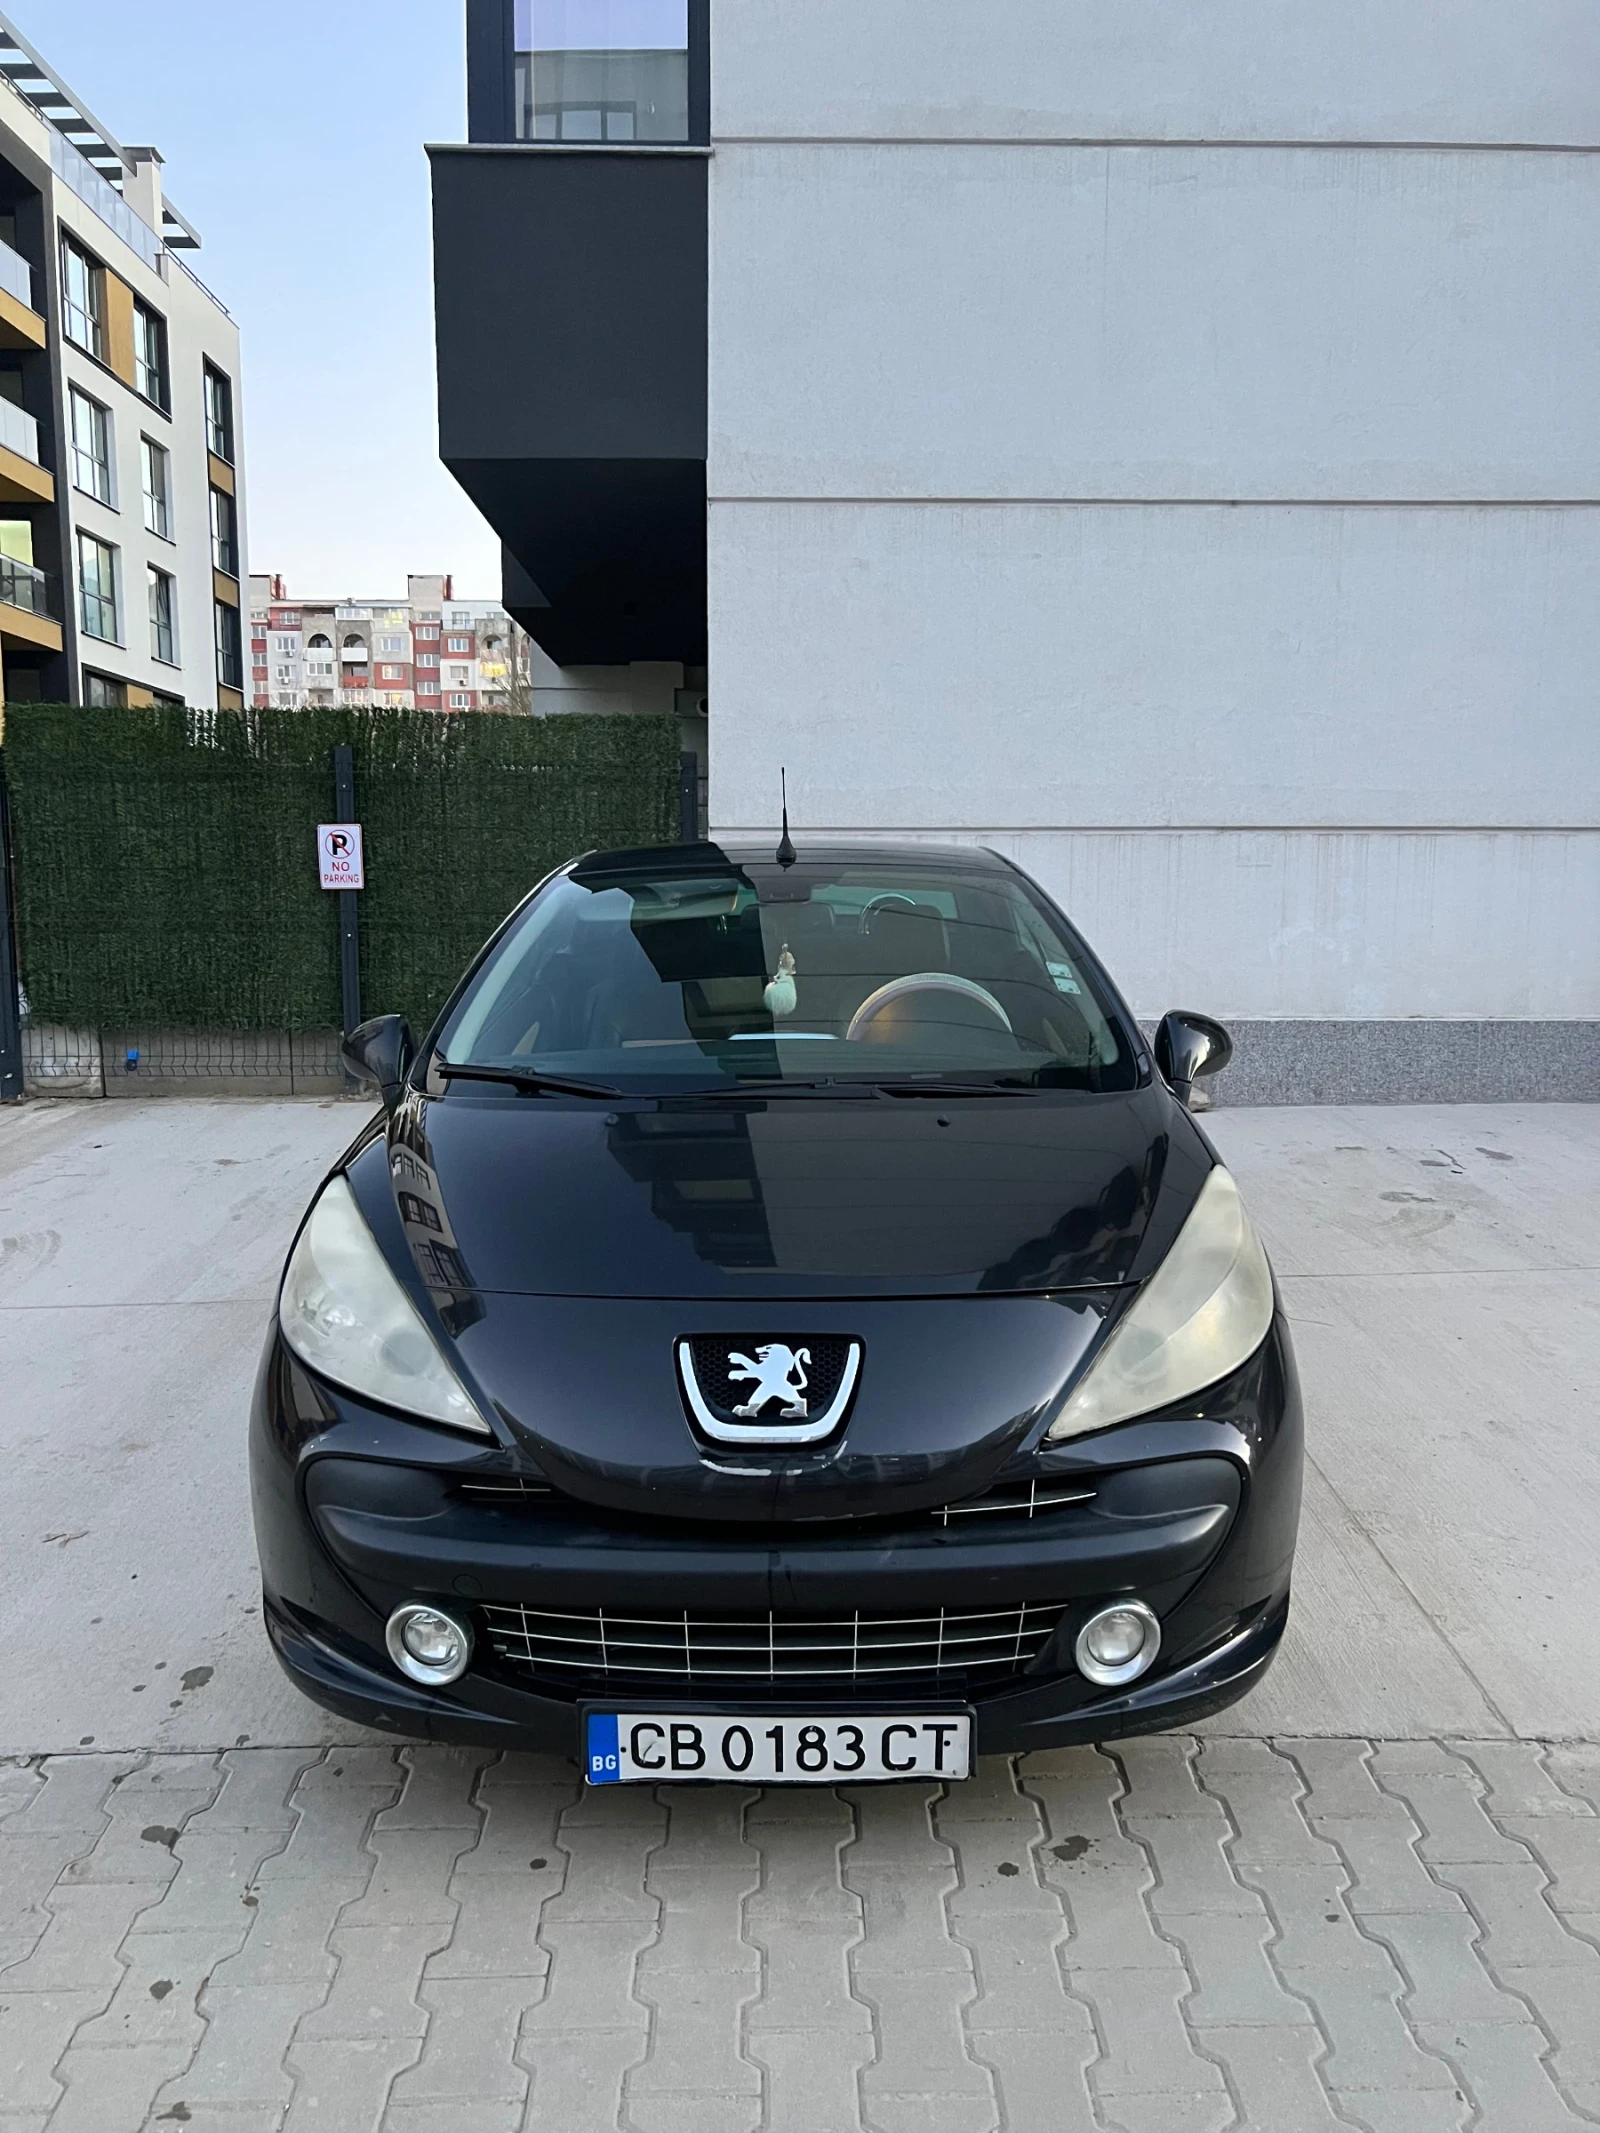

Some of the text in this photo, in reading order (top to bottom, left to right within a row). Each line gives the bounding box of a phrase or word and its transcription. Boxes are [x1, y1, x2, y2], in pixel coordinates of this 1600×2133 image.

[332, 834, 347, 855] P
[332, 862, 350, 871] NO
[324, 874, 359, 883] PARKING
[630, 1722, 957, 1772] CB 0183 CT
[592, 1755, 616, 1771] BG
